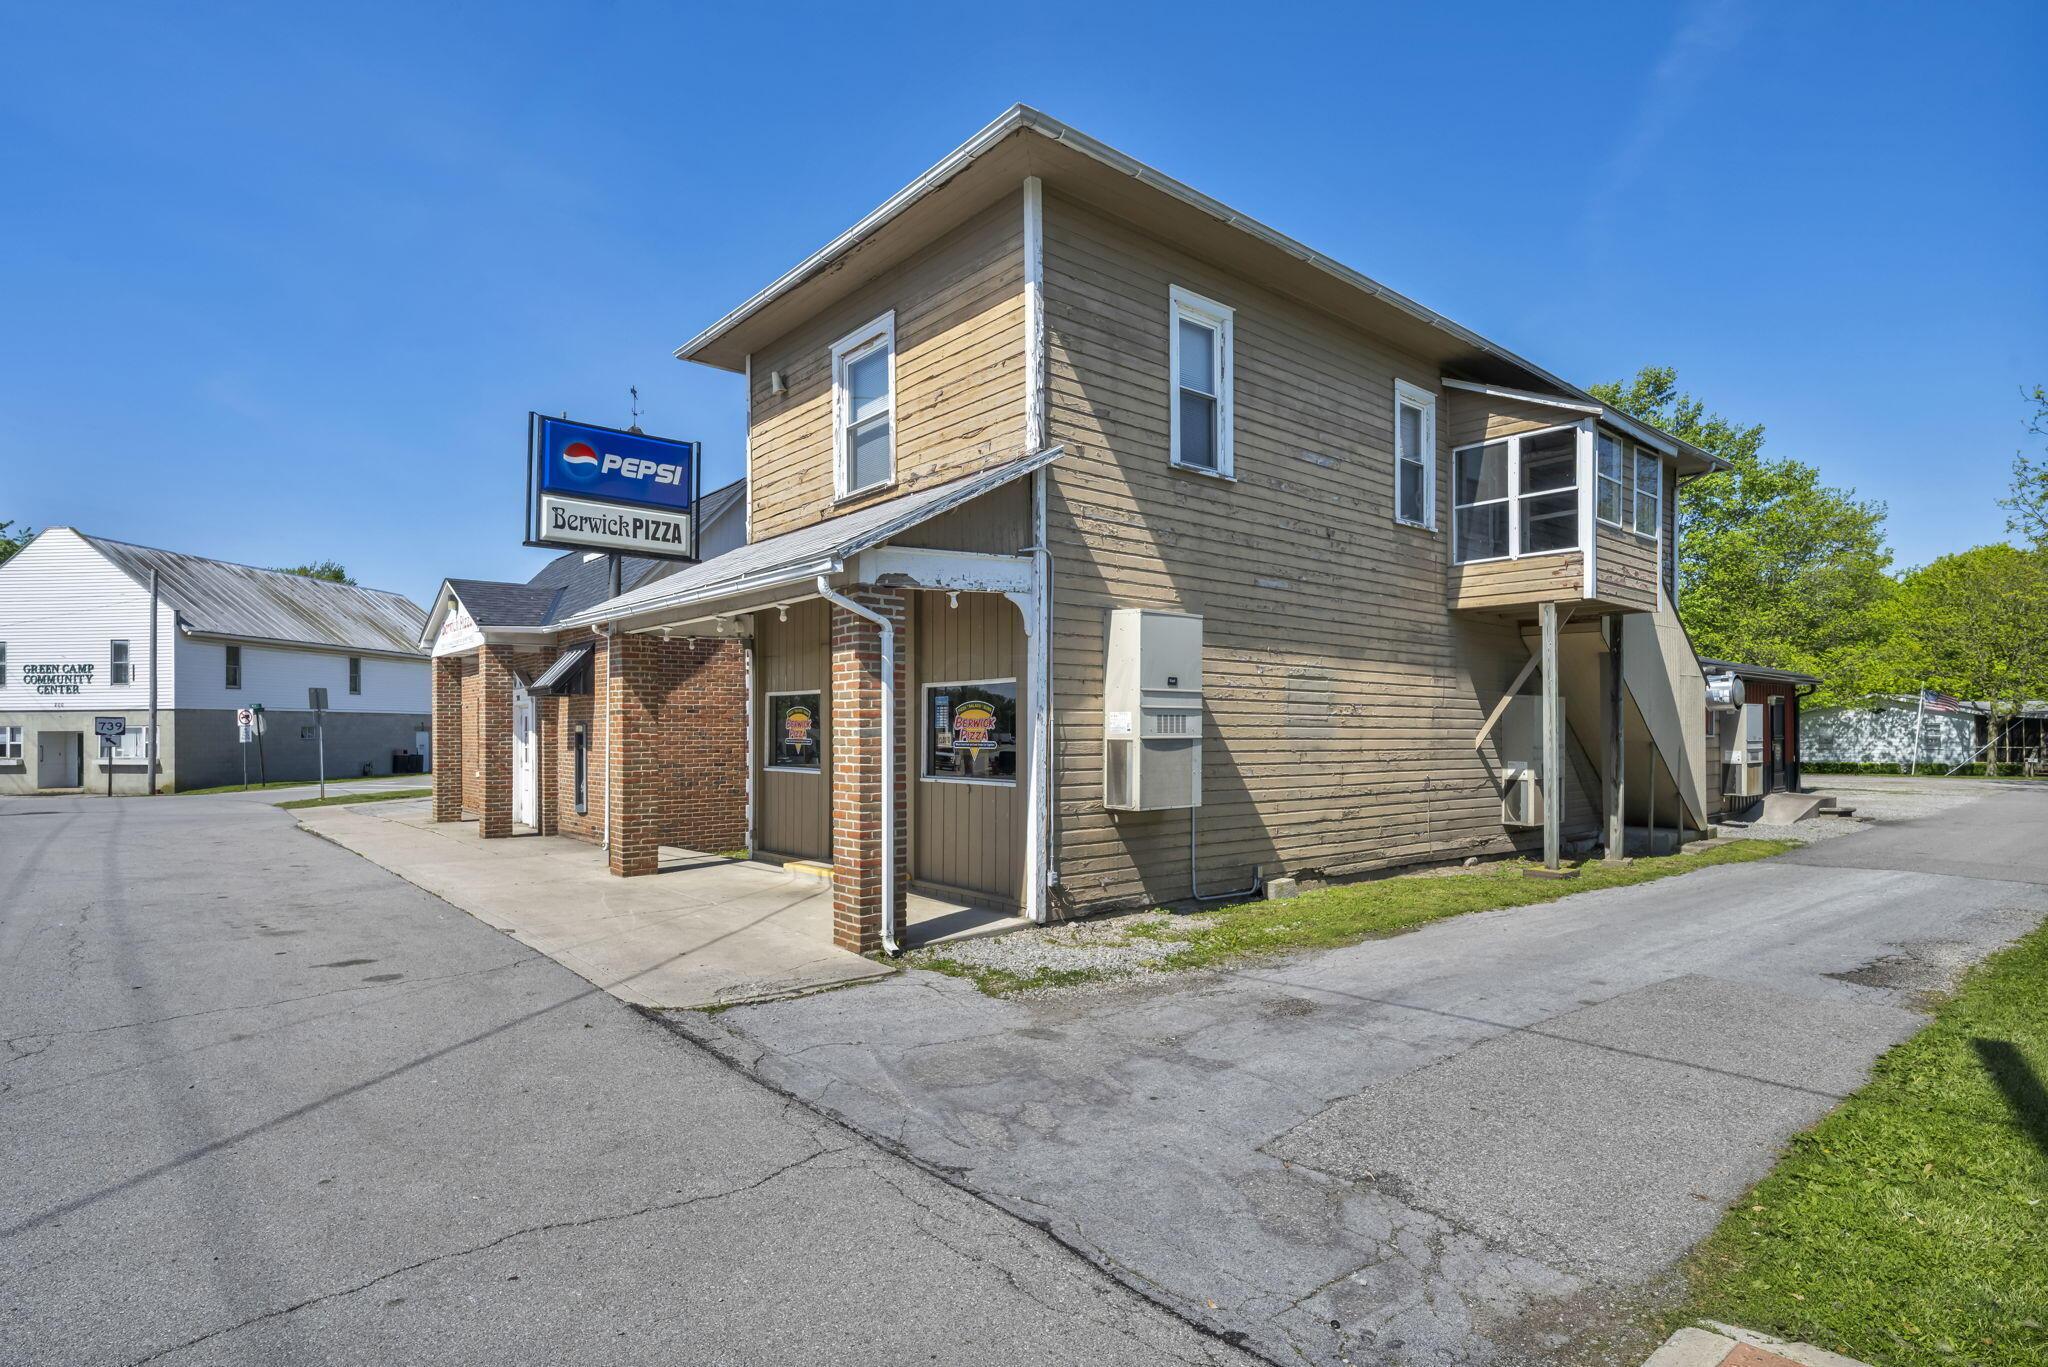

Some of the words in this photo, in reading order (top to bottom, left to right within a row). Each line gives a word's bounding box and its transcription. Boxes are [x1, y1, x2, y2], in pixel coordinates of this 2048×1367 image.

[601, 453, 682, 486] PEPSI
[552, 506, 630, 537] Berwick
[632, 517, 682, 544] PIZZA
[23, 664, 60, 674] GREEN
[62, 664, 94, 673] CAMP
[23, 674, 94, 684] COMMUNITY
[37, 684, 80, 694] CENTER
[98, 721, 123, 731] 739
[786, 720, 812, 729] BERWICK
[955, 716, 995, 729] BERWICK
[961, 730, 988, 740] PIZZA
